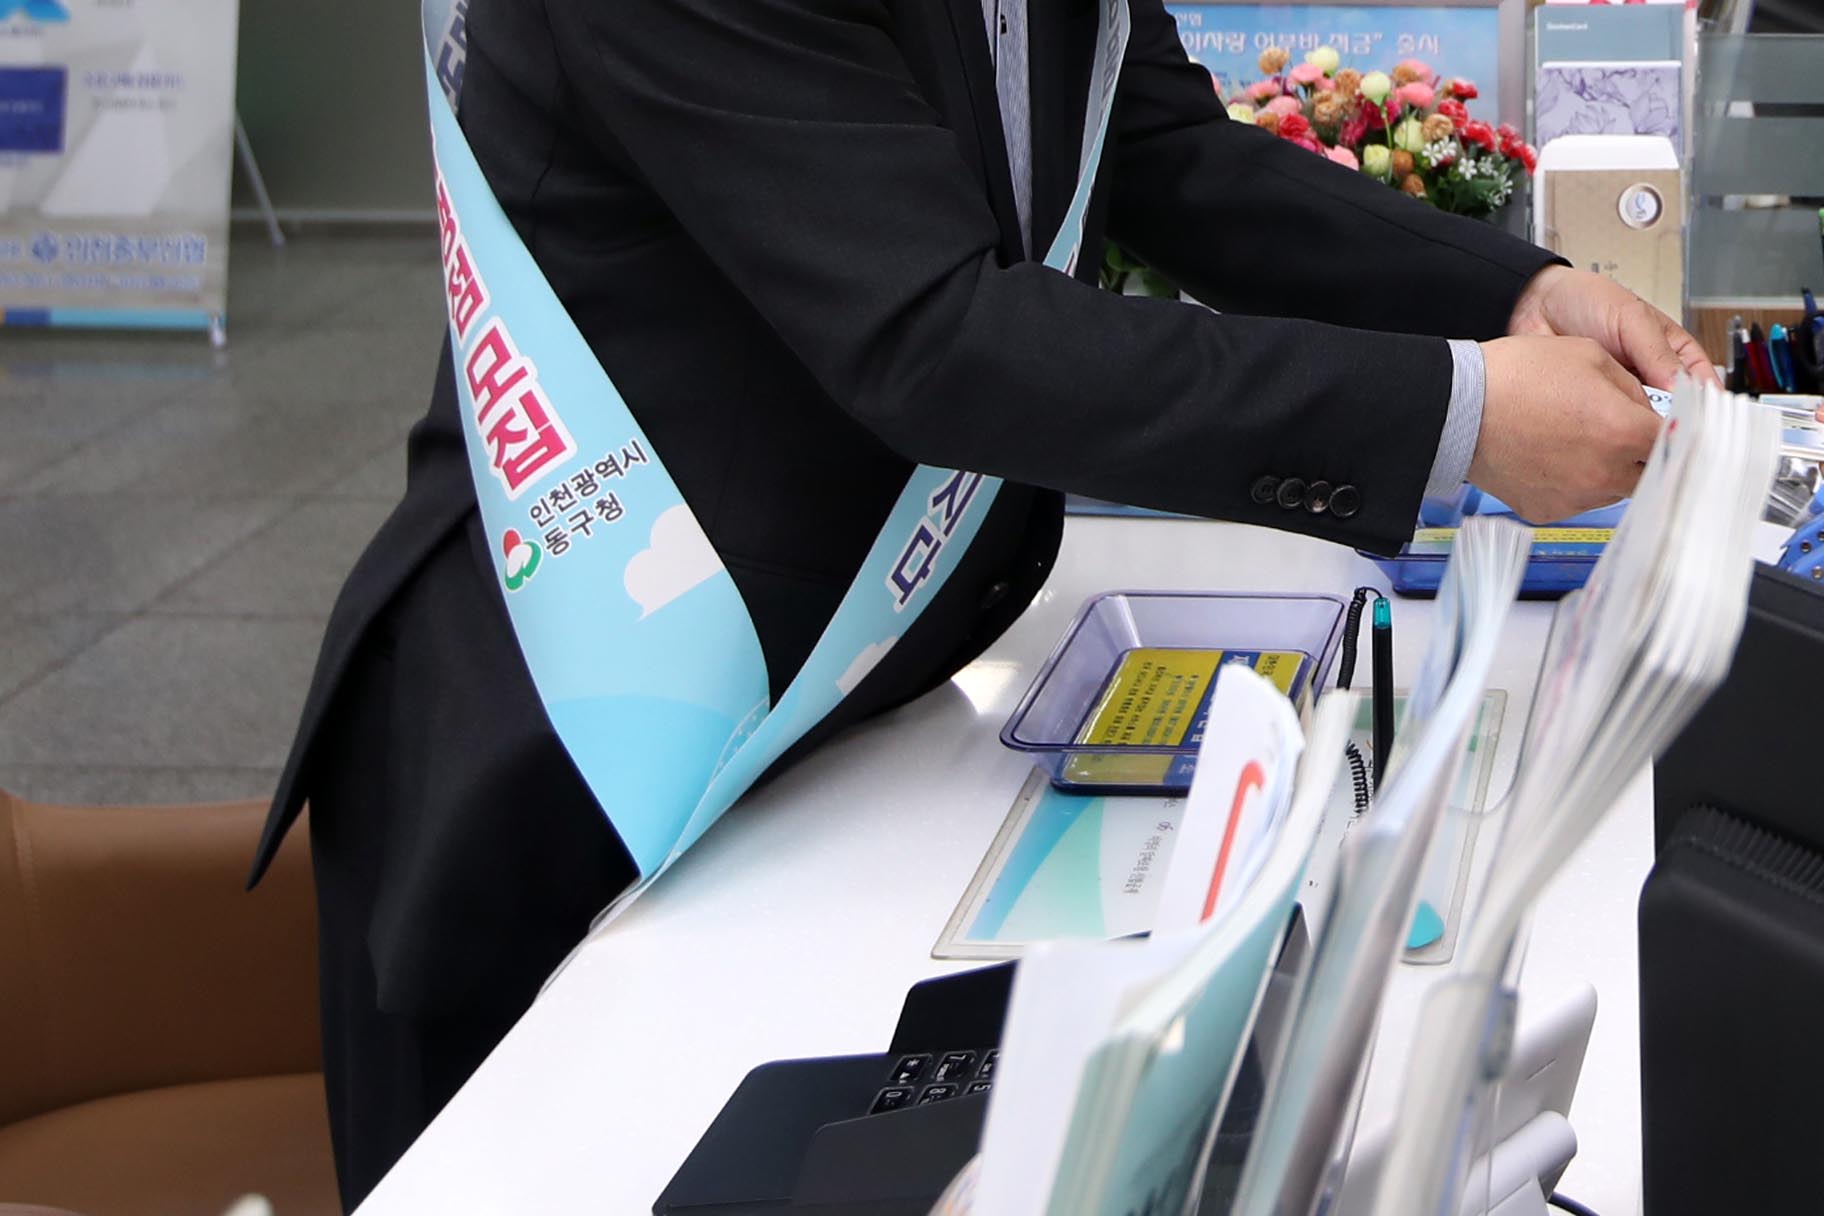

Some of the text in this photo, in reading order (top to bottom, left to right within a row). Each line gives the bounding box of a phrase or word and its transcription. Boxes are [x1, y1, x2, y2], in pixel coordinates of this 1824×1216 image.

[464, 324, 569, 493] 모집
[527, 437, 649, 526] 인천광역시
[543, 496, 626, 558] 동구청
